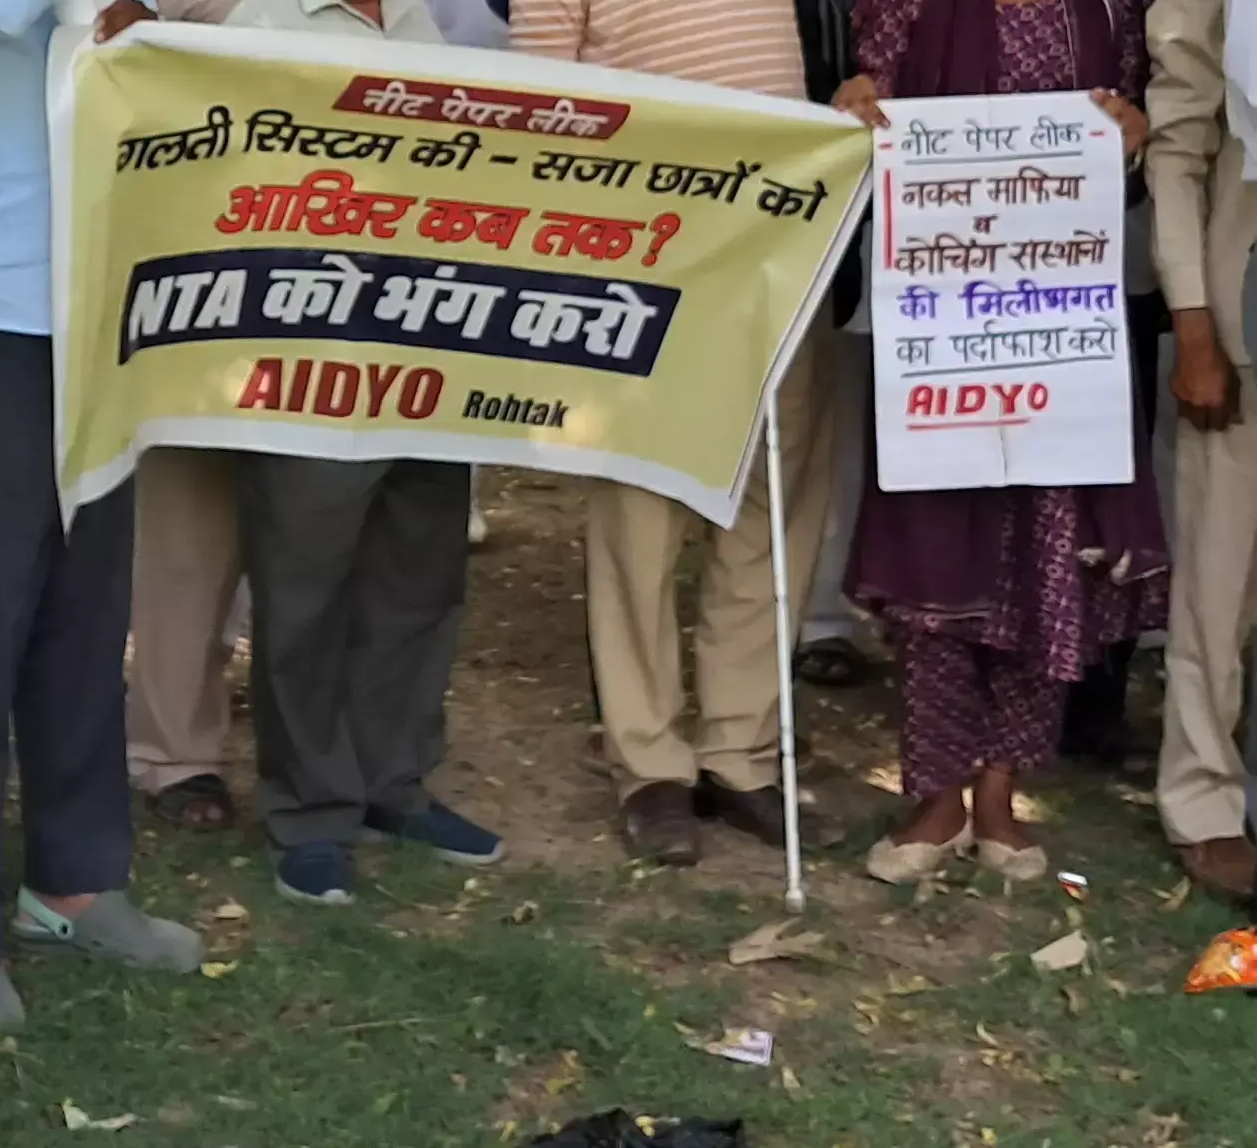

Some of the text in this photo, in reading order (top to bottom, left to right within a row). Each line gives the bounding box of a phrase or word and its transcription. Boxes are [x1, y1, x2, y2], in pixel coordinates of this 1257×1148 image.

[362, 81, 608, 137] नीट पेपर लीक
[901, 116, 1083, 155] नीट पेपर लीक
[115, 105, 232, 173] गलती
[243, 110, 404, 163] सिस्टम
[409, 131, 481, 171] की
[532, 150, 640, 188] सजा
[646, 159, 761, 204] छात्रों
[757, 178, 828, 222] को
[988, 166, 1085, 204] माफिया
[215, 169, 682, 267] आखिर कब तक?
[894, 235, 1005, 278] कोचिंग
[128, 252, 658, 359] NTA को भंग करो
[898, 278, 1117, 320] की मिलीभगत
[896, 334, 934, 365] का
[1069, 320, 1117, 355] करो
[236, 356, 569, 429] AIDYO Rohtak
[906, 382, 1050, 417] AIDYO
